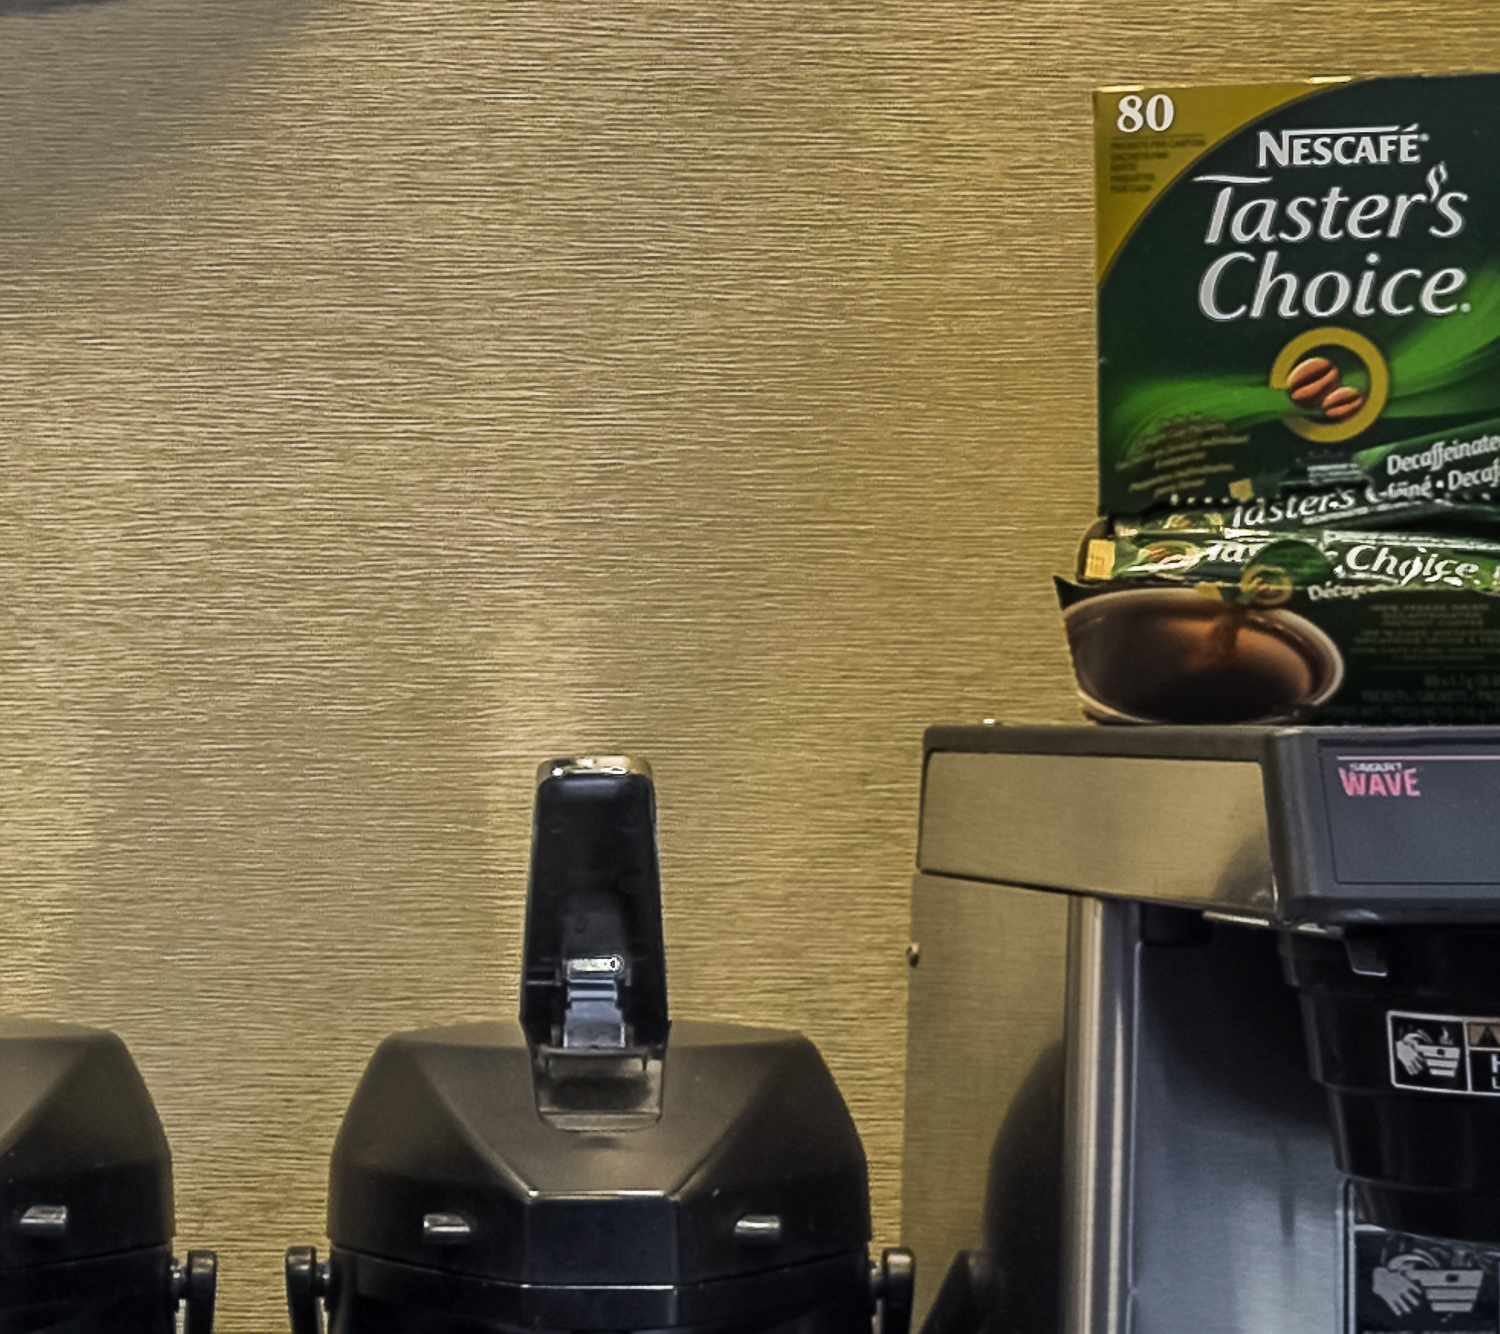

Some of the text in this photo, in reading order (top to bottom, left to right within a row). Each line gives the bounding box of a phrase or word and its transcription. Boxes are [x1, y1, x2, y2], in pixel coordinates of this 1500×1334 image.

[1117, 94, 1174, 133] 80
[1258, 123, 1422, 168] NESCAFÉ
[1193, 161, 1469, 245] Taster's
[1338, 767, 1421, 797] WAVE
